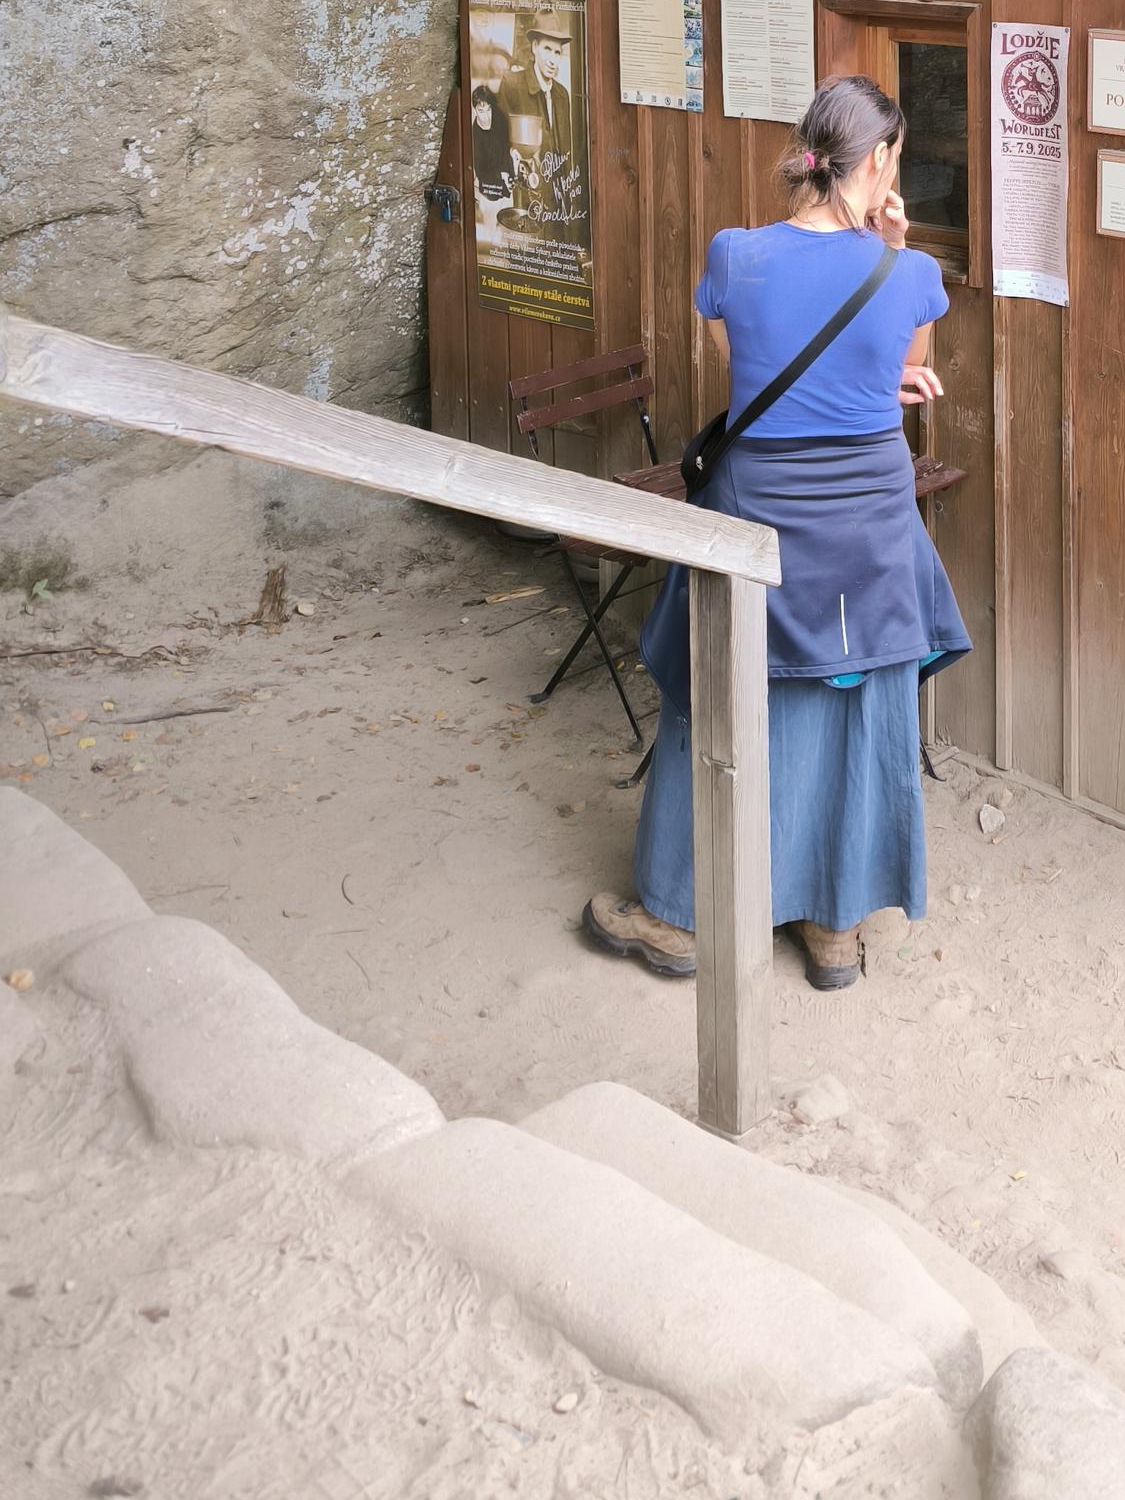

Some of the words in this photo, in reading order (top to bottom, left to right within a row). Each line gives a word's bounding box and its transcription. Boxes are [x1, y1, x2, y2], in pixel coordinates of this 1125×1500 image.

[1000, 31, 1060, 60] LODŽIE
[1000, 118, 1062, 141] WORLDFEST
[481, 275, 487, 286] Z
[487, 277, 512, 291] vlastní
[512, 283, 543, 300] pražírny
[543, 289, 562, 302] stále
[562, 291, 590, 308] čerstvá
